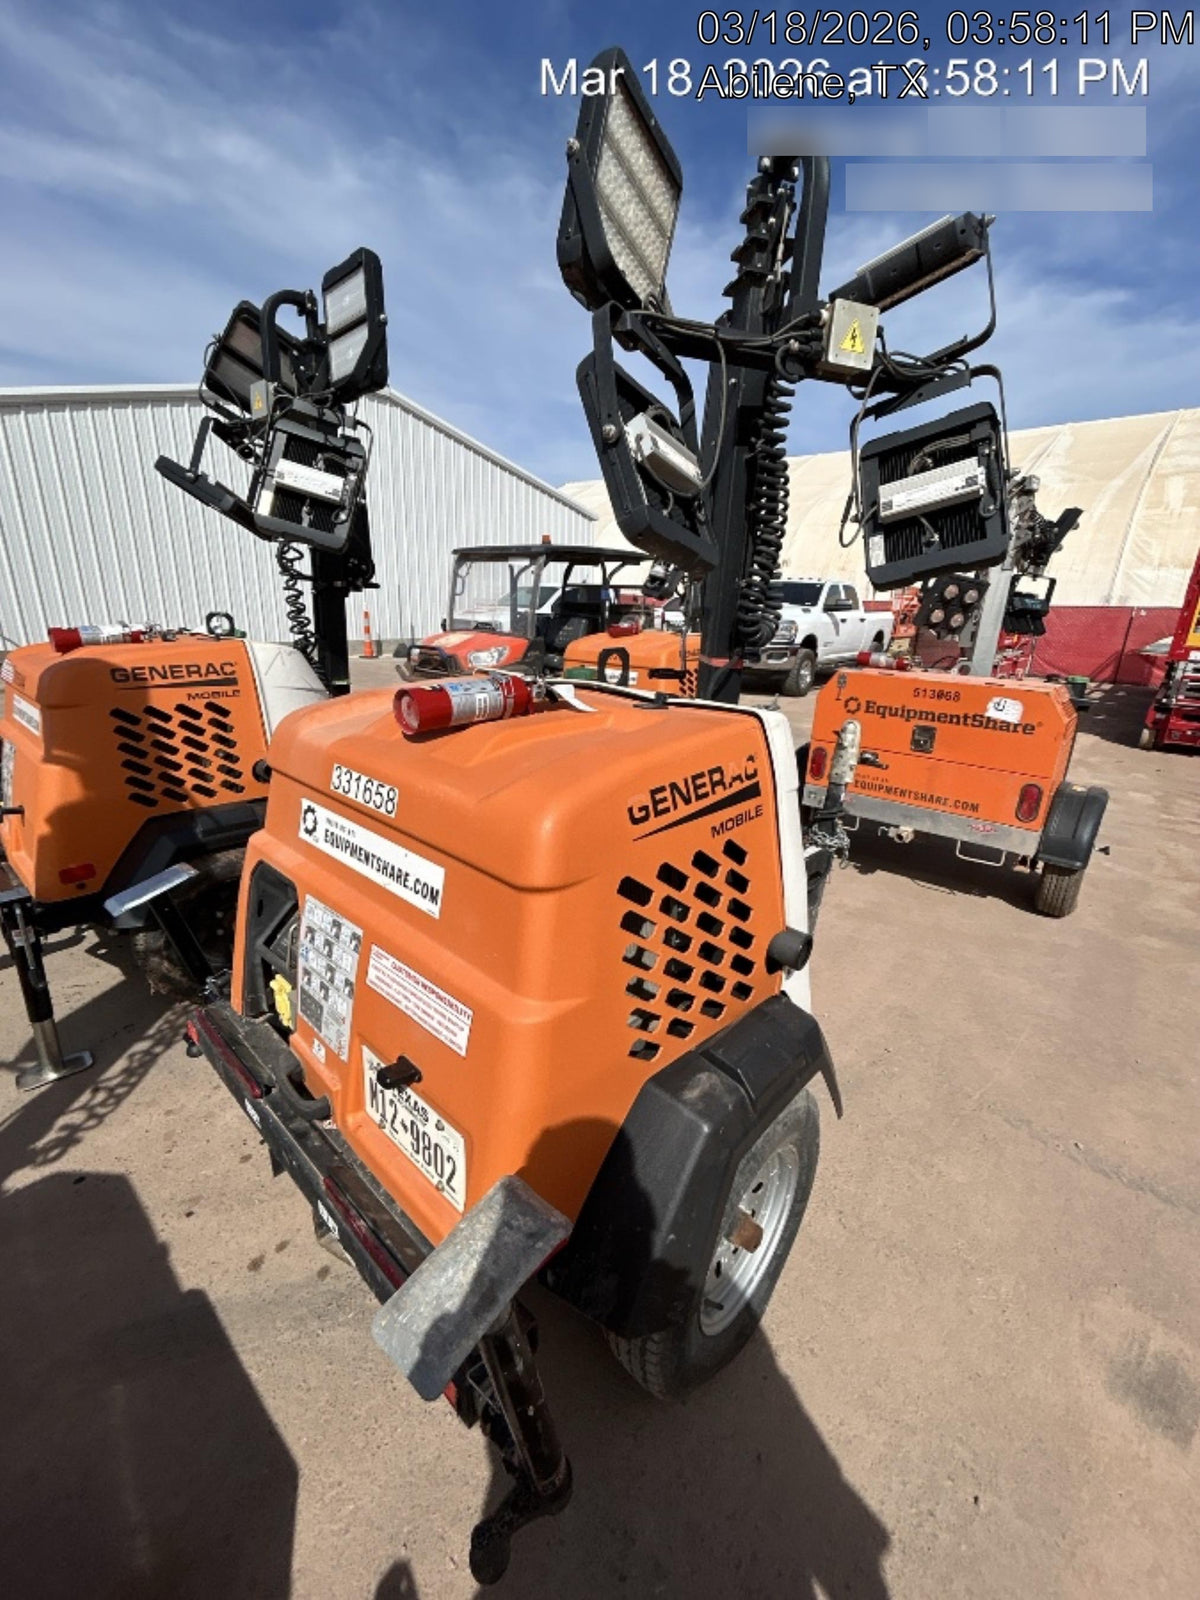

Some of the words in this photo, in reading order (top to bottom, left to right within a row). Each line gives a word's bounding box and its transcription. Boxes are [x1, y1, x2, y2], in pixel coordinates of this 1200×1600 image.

[110, 661, 237, 683] GENERAC
[187, 690, 241, 701] MOBILE
[864, 699, 1036, 735] EquipmentShare
[332, 765, 397, 815] 331658
[627, 755, 759, 826] GENERAC
[854, 779, 980, 813] EQUIPMENTSHARE.COM
[711, 805, 764, 839] MOBILE
[324, 829, 440, 906] EQUIPMENTSHARE.COM
